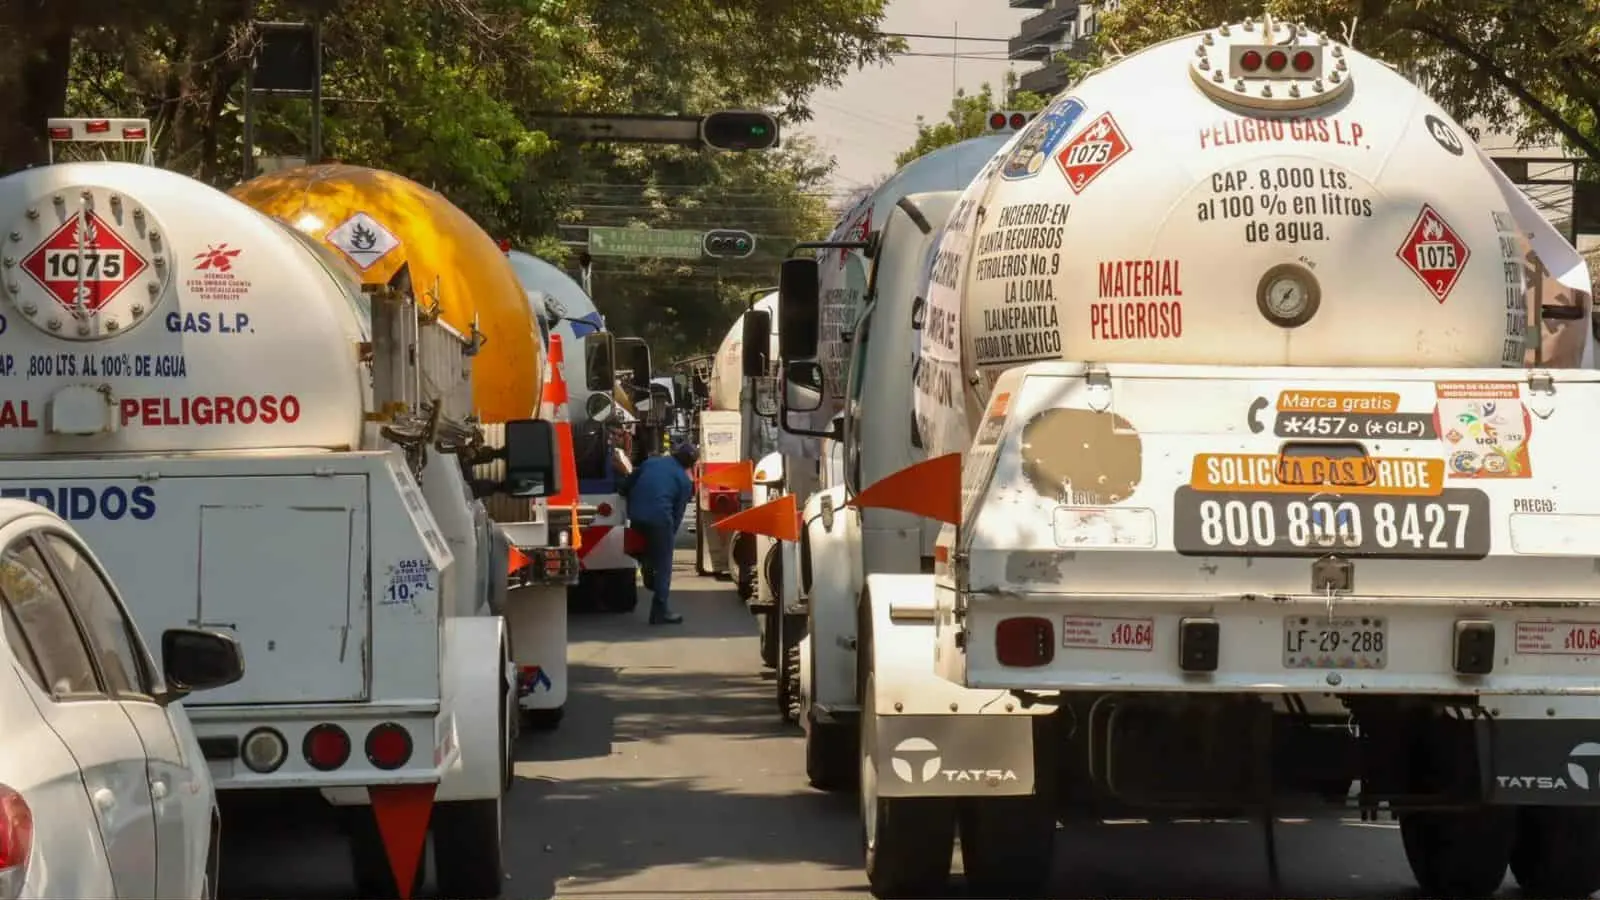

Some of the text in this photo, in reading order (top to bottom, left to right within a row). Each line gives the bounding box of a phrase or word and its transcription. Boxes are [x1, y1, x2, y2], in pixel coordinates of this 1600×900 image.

[1200, 116, 1371, 150] PELIGRO GAS L.P.
[1070, 143, 1109, 164] 1075
[1076, 173, 1085, 185] 2
[1212, 168, 1353, 193] CAP. 8,000 Lts.
[1198, 193, 1373, 221] al 100 % en litros
[977, 227, 1064, 256] PLANTA RECURSOS
[1246, 220, 1330, 243] de agua.
[47, 252, 121, 278] 1075
[976, 253, 1027, 280] PETROLEROS
[1418, 246, 1456, 269] 1075
[1004, 279, 1057, 303] LA LOMA.
[1099, 259, 1182, 298] MATERIAL
[1436, 279, 1444, 293] 2
[166, 311, 255, 335] GAS L.P.
[984, 304, 1059, 332] TLALNEPANTLA
[1090, 301, 1182, 339] PELIGROSO
[1002, 334, 1015, 357] DE
[1015, 330, 1062, 355] MEXICO
[56, 354, 79, 377] LTS.
[83, 354, 97, 377] AL
[101, 353, 131, 377] 100%
[135, 354, 150, 377] DE
[154, 354, 187, 378] AGUA
[120, 395, 301, 426] PELIGROSO
[1283, 393, 1392, 412] Marca gratis
[1207, 457, 1305, 485] SOLICITA
[1311, 459, 1355, 485] GAS
[1200, 500, 1470, 549] 800 800 8427
[1111, 623, 1152, 645] $10.64
[1287, 630, 1384, 653] LF-29-288
[1564, 628, 1600, 649] $10.6
[942, 769, 1018, 781] TATSA
[1496, 775, 1568, 789] TATSA
